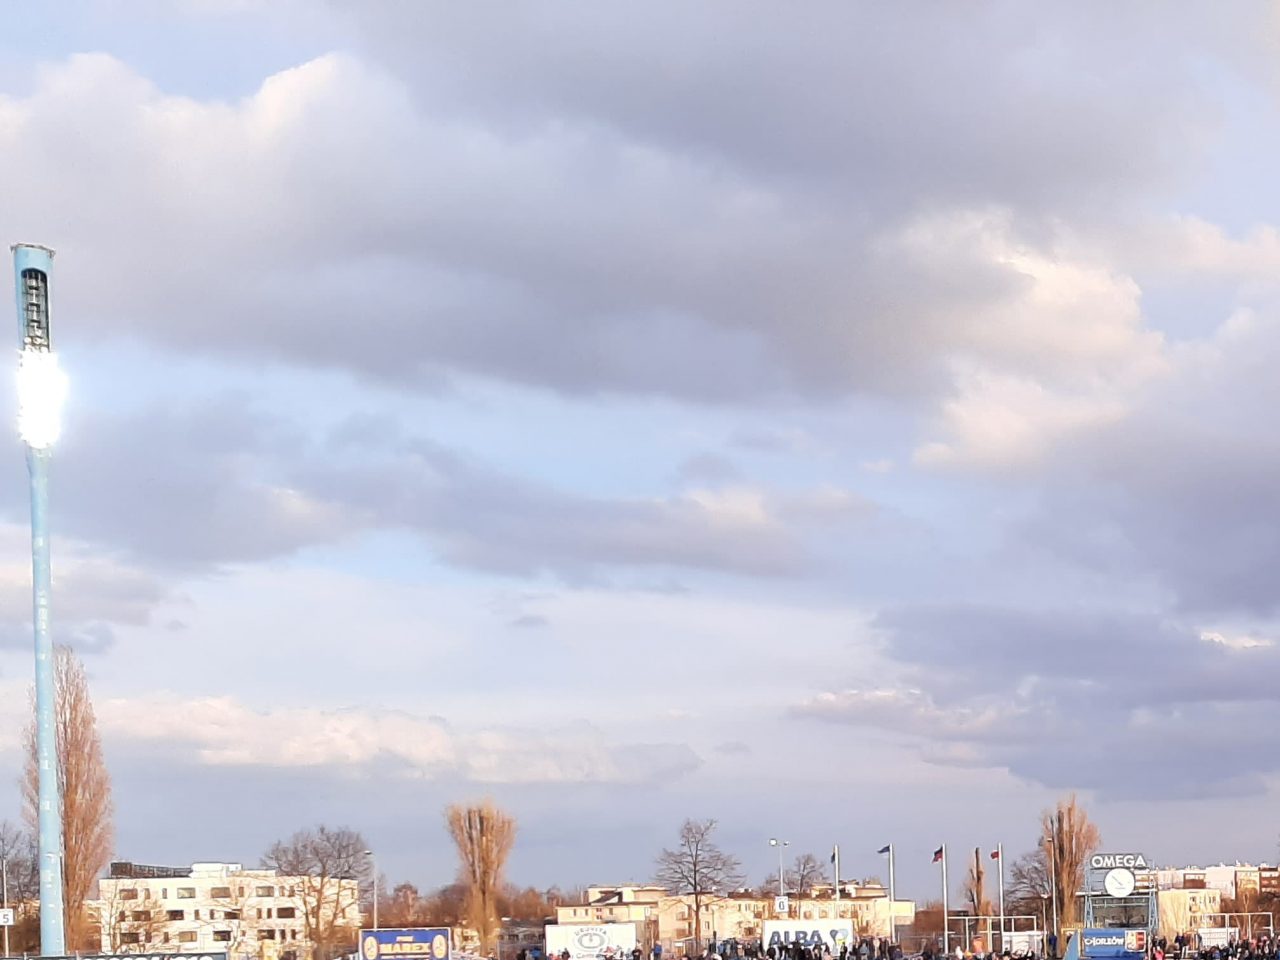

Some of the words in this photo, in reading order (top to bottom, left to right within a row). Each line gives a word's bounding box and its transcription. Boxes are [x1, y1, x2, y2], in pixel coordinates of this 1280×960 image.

[1091, 855, 1146, 868] OMEGA
[2, 914, 10, 924] 5
[769, 930, 823, 945] ALBA
